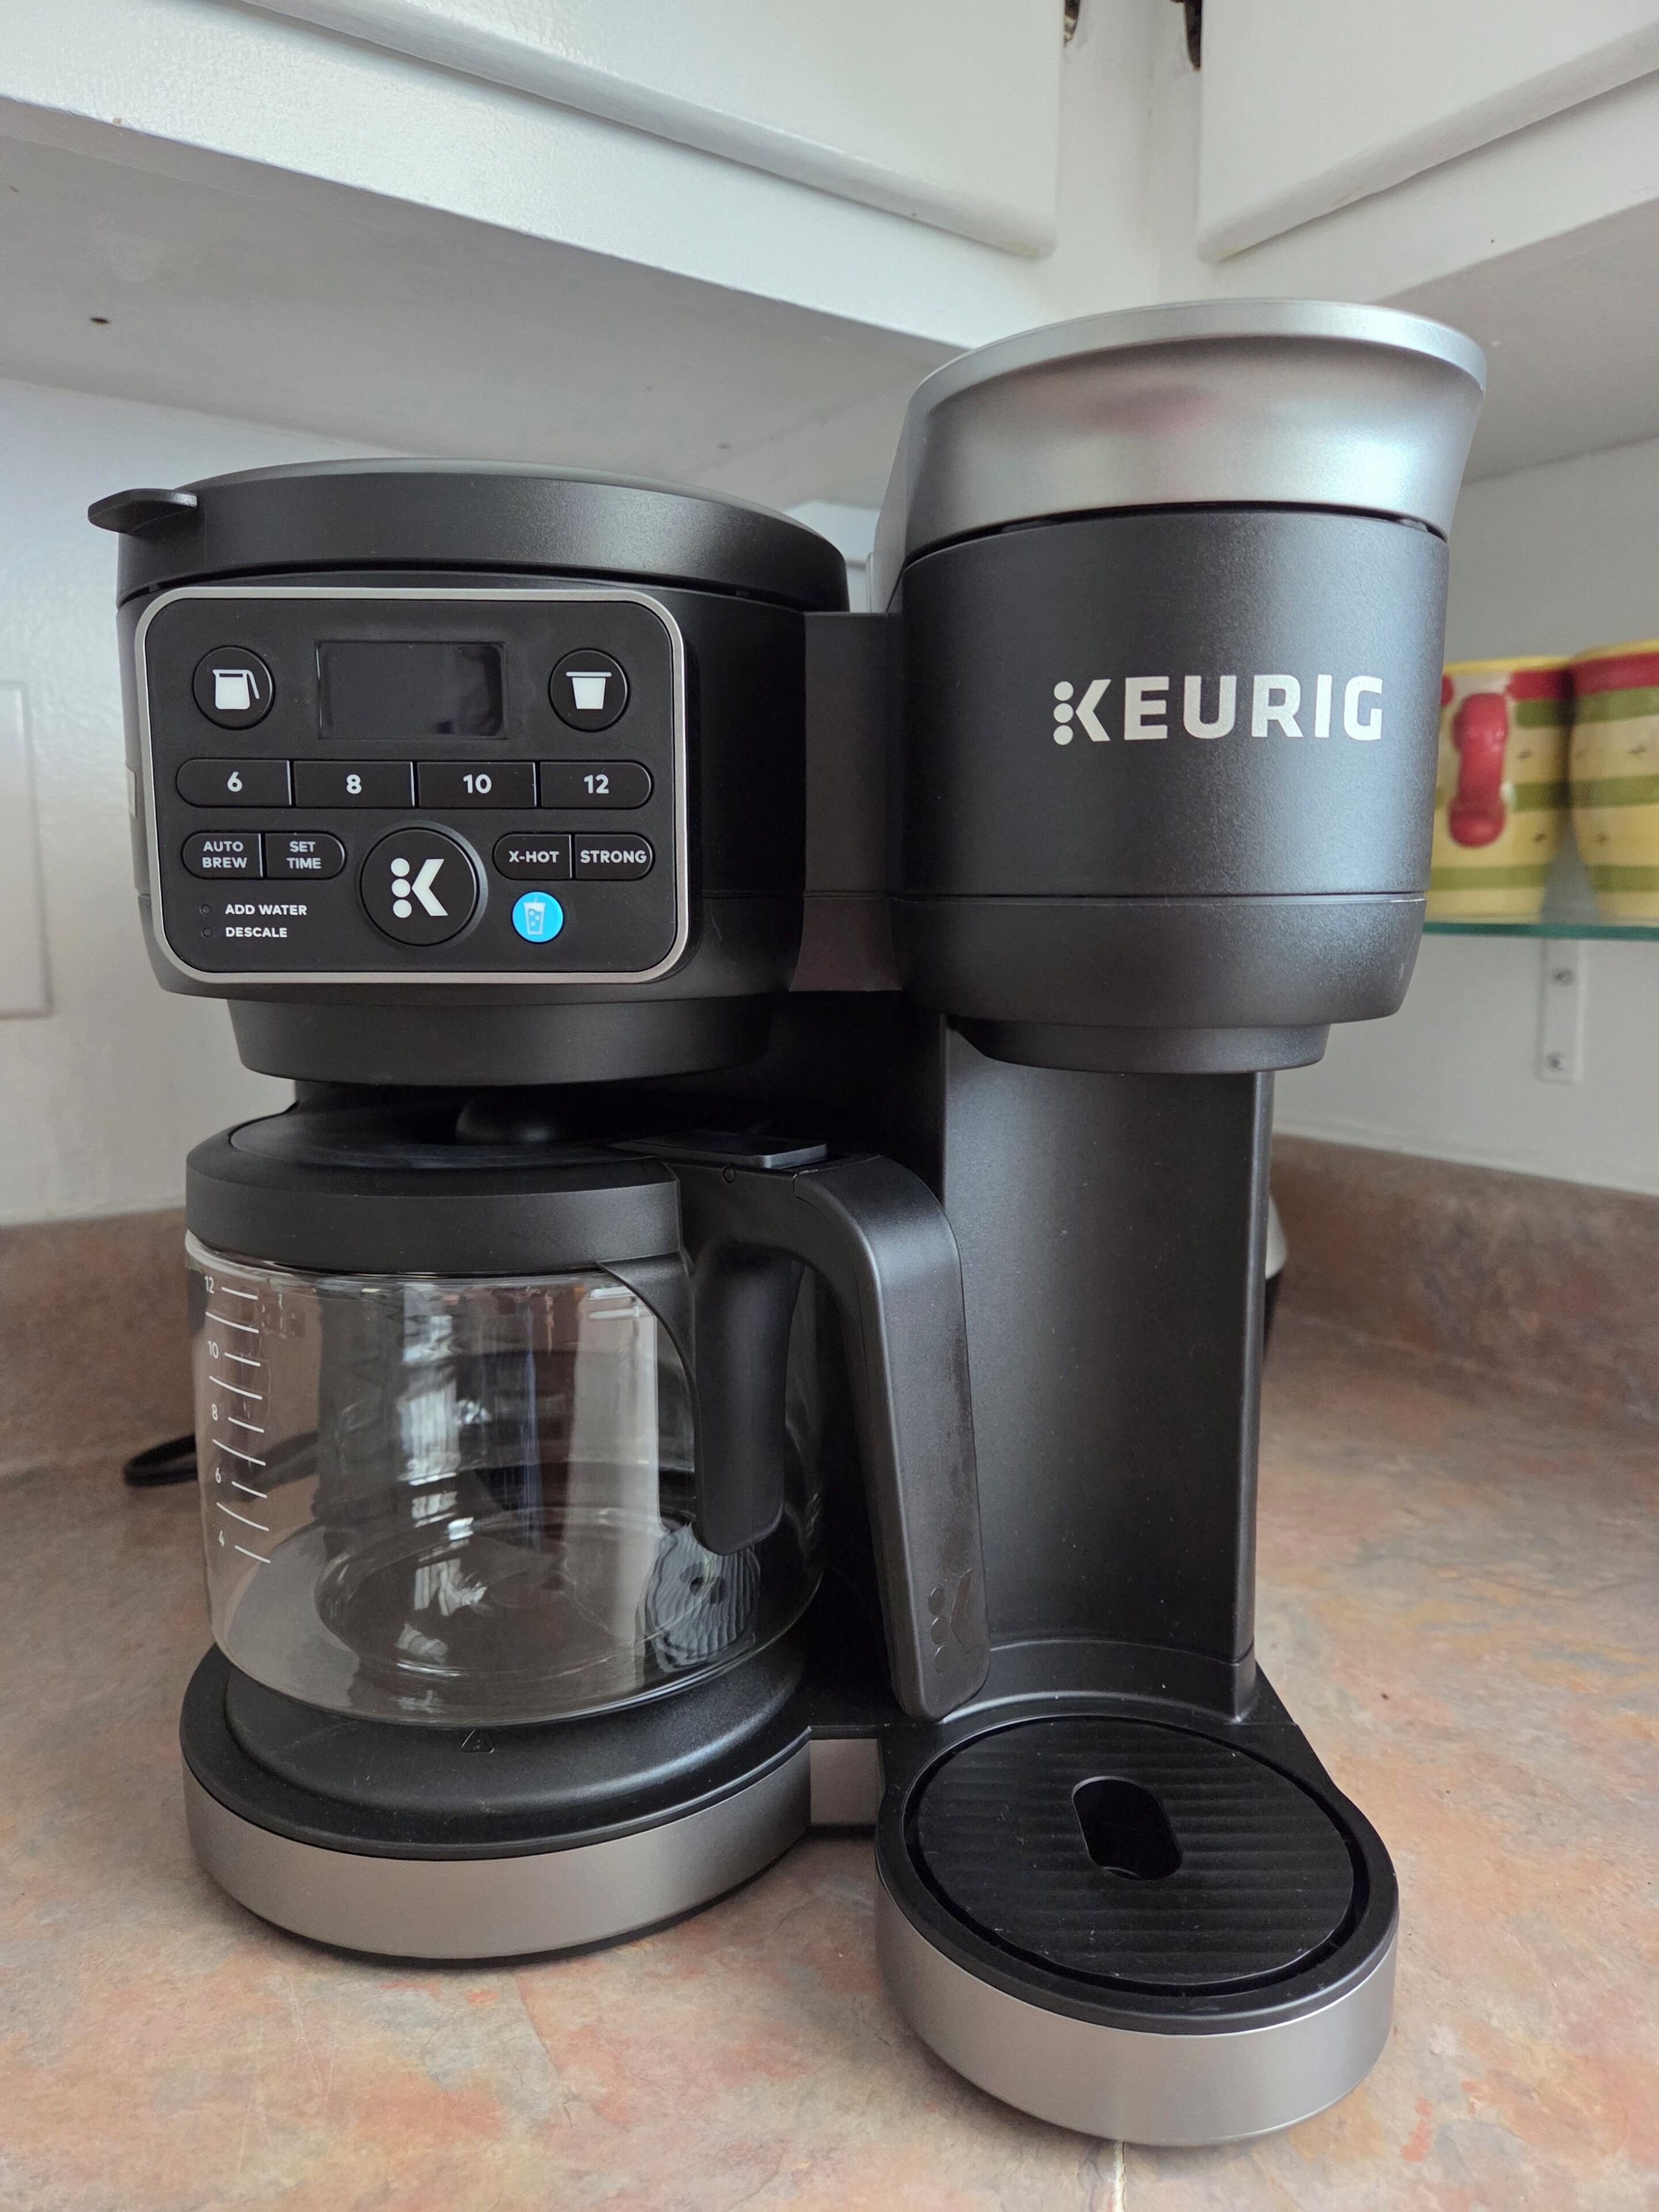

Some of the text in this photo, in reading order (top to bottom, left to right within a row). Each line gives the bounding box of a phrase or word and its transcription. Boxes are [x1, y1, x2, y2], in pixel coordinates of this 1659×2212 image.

[1053, 674, 1383, 745] KEURIG
[227, 771, 243, 792] 6
[346, 774, 362, 794] 8
[463, 774, 492, 794] 10
[584, 774, 609, 794] 12
[203, 841, 244, 852] AUTO
[289, 840, 316, 853] SET
[202, 857, 248, 868] BREW
[286, 857, 321, 869] TIME
[509, 850, 559, 863] X-HOT
[580, 850, 647, 863] STRONG
[225, 904, 307, 915] ADD WATER
[225, 927, 287, 938] DESCALE
[204, 1275, 215, 1294] 12
[207, 1340, 219, 1359] 10
[211, 1403, 218, 1421] 8
[215, 1467, 221, 1484] 6
[218, 1530, 225, 1547] 4
